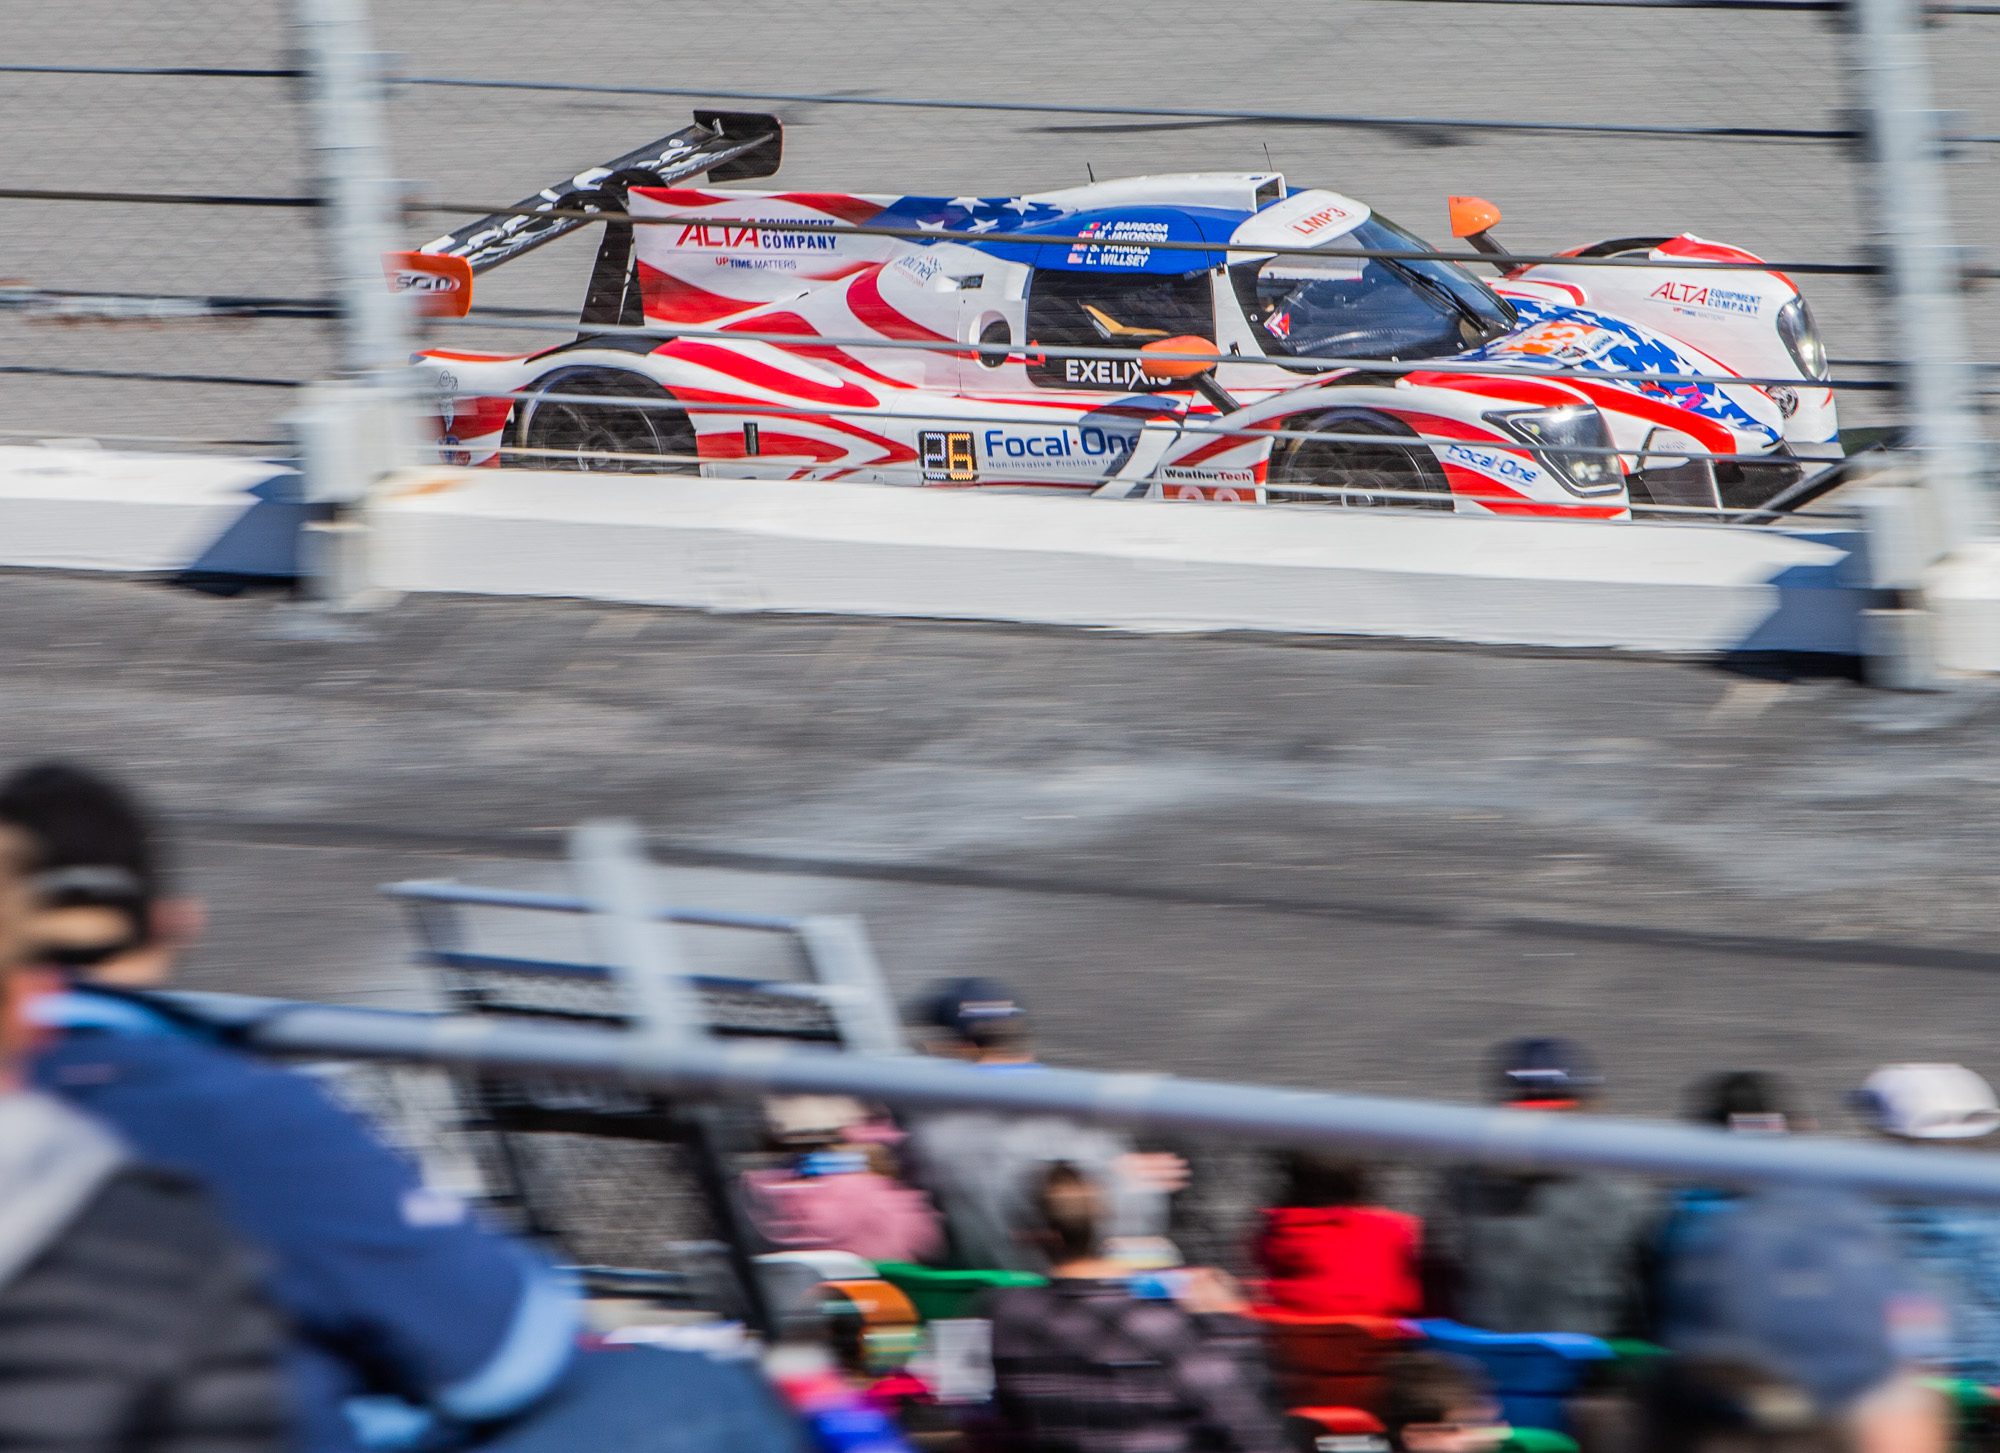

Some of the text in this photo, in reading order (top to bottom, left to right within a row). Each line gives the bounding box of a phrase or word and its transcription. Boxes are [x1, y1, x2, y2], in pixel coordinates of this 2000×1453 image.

[676, 217, 760, 248] ALTA
[1114, 221, 1169, 233] BARBOSA
[762, 234, 836, 249] COMPANY
[1108, 231, 1168, 242] JAKOBSEN
[754, 259, 797, 270] MATTERS
[1101, 253, 1149, 268] WILLSEY
[1650, 282, 1708, 305] ALTA
[1710, 288, 1761, 303] EQUIPMENT
[1708, 299, 1759, 314] COMPANY
[1066, 357, 1171, 391] EXELIX
[1165, 469, 1251, 481] WeatherTech
